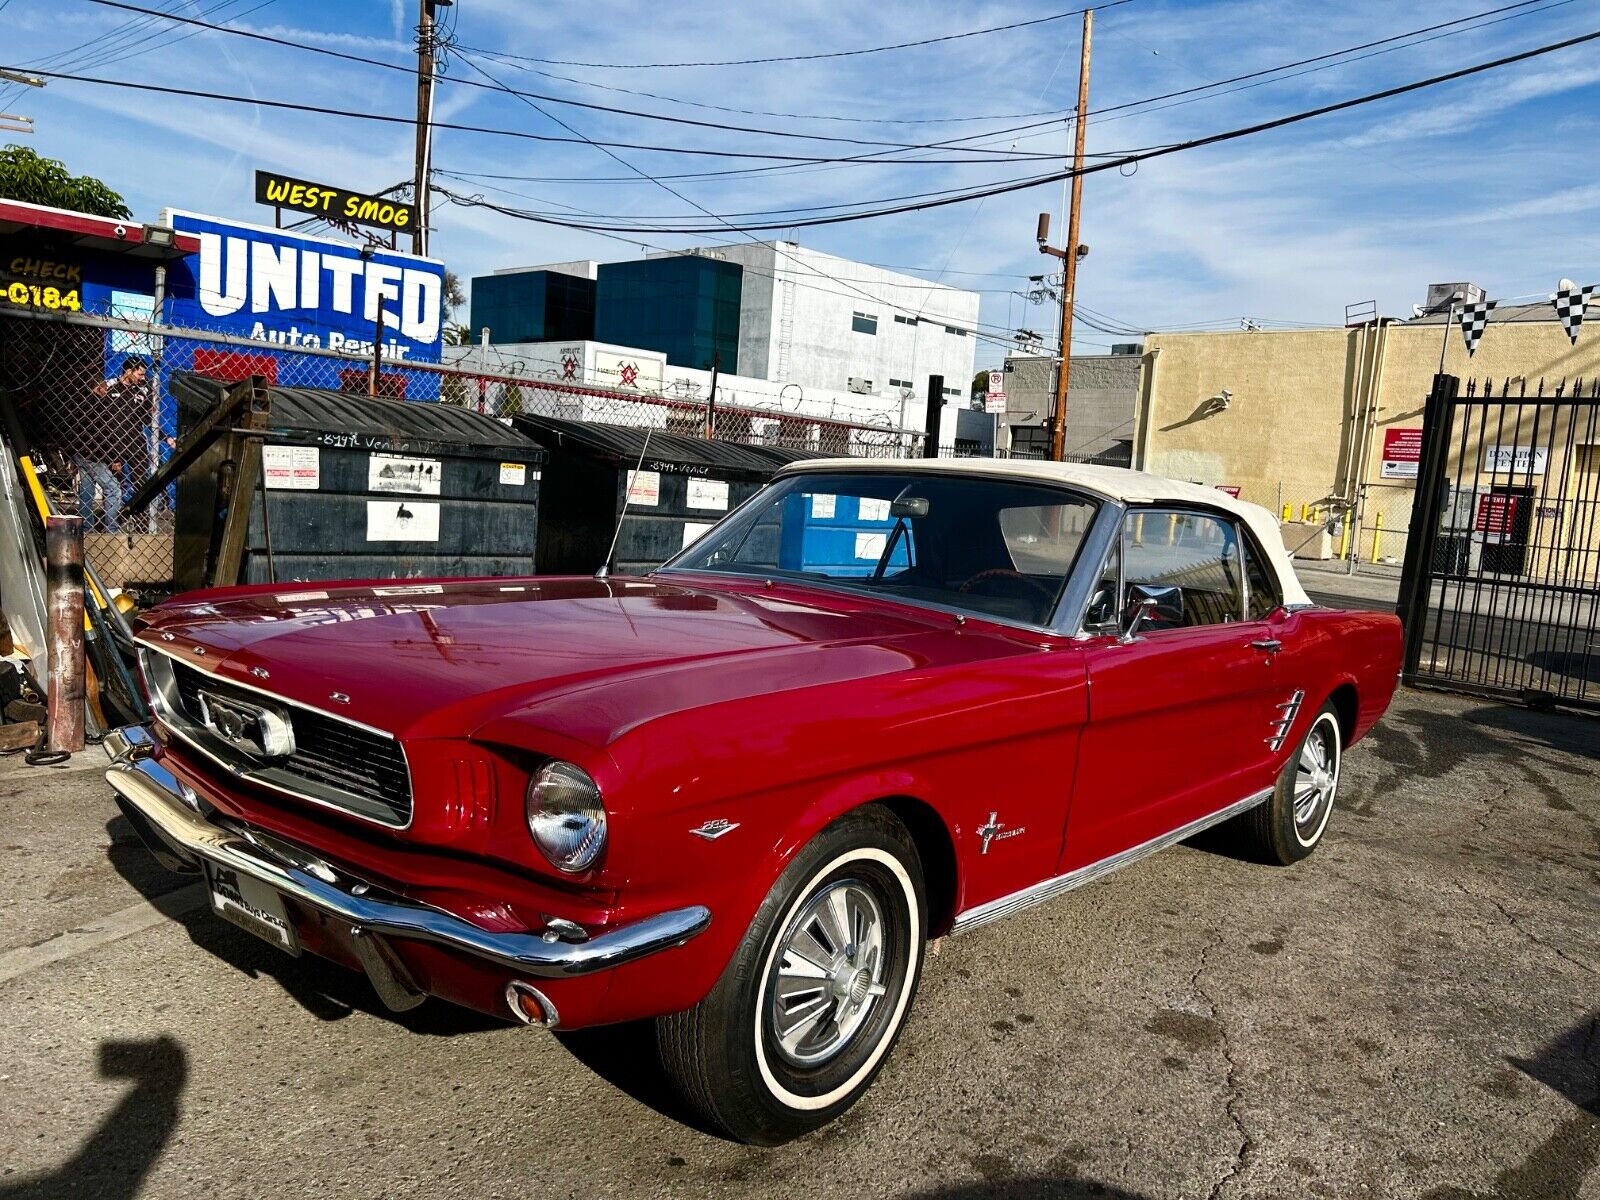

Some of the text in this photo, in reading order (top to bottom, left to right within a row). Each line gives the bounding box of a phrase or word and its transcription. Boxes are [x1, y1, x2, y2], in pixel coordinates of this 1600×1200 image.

[266, 179, 409, 226] WEST SMOG
[10, 257, 81, 283] CHECK
[200, 232, 442, 344] UNITED
[250, 321, 410, 359] Auto Repair
[1489, 450, 1543, 459] DONTIN
[1495, 459, 1536, 468] ENTE
[1483, 496, 1514, 504] ATENTIN
